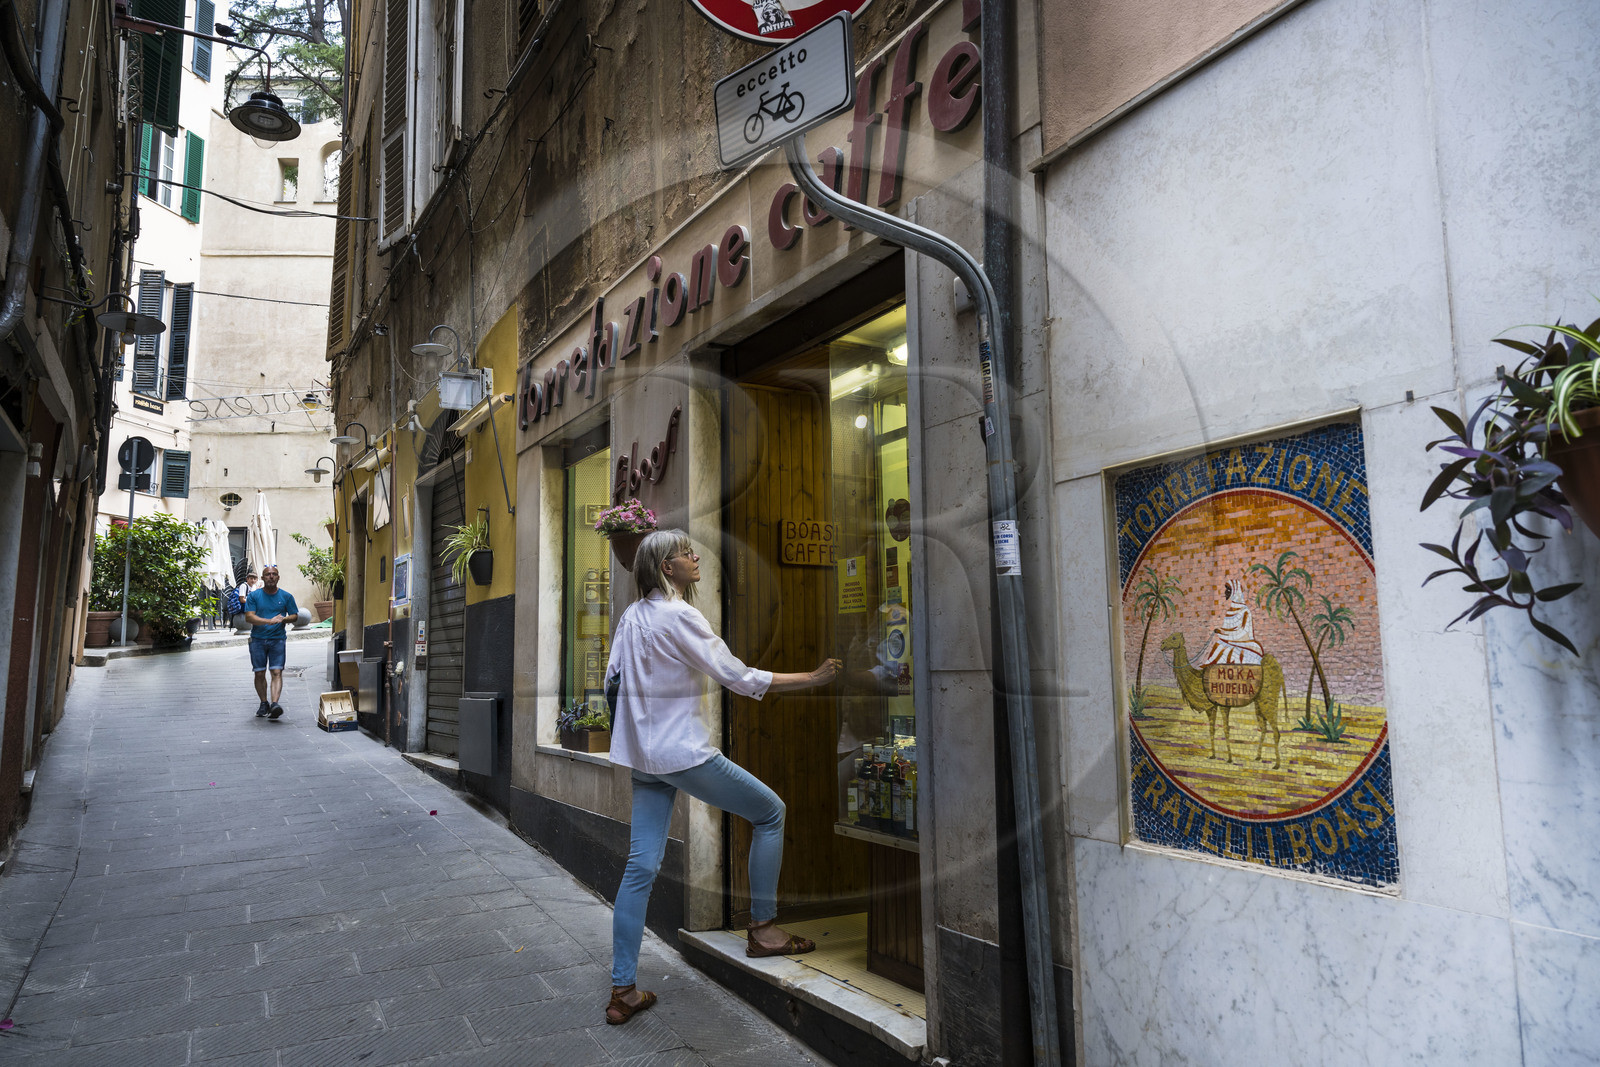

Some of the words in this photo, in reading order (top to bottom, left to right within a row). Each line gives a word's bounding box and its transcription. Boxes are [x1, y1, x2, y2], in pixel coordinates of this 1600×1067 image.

[760, 19, 794, 34] ANTIFA!
[736, 48, 807, 98] eccetto
[518, 225, 750, 431] torrefazione
[1119, 446, 1369, 548] TORREFAZIONE
[786, 521, 839, 541] BOASI
[1211, 682, 1255, 694] HODEIDA
[1217, 667, 1255, 680] MOKA
[1131, 756, 1277, 866] FRATELLI
[1283, 780, 1395, 865] BOASI
